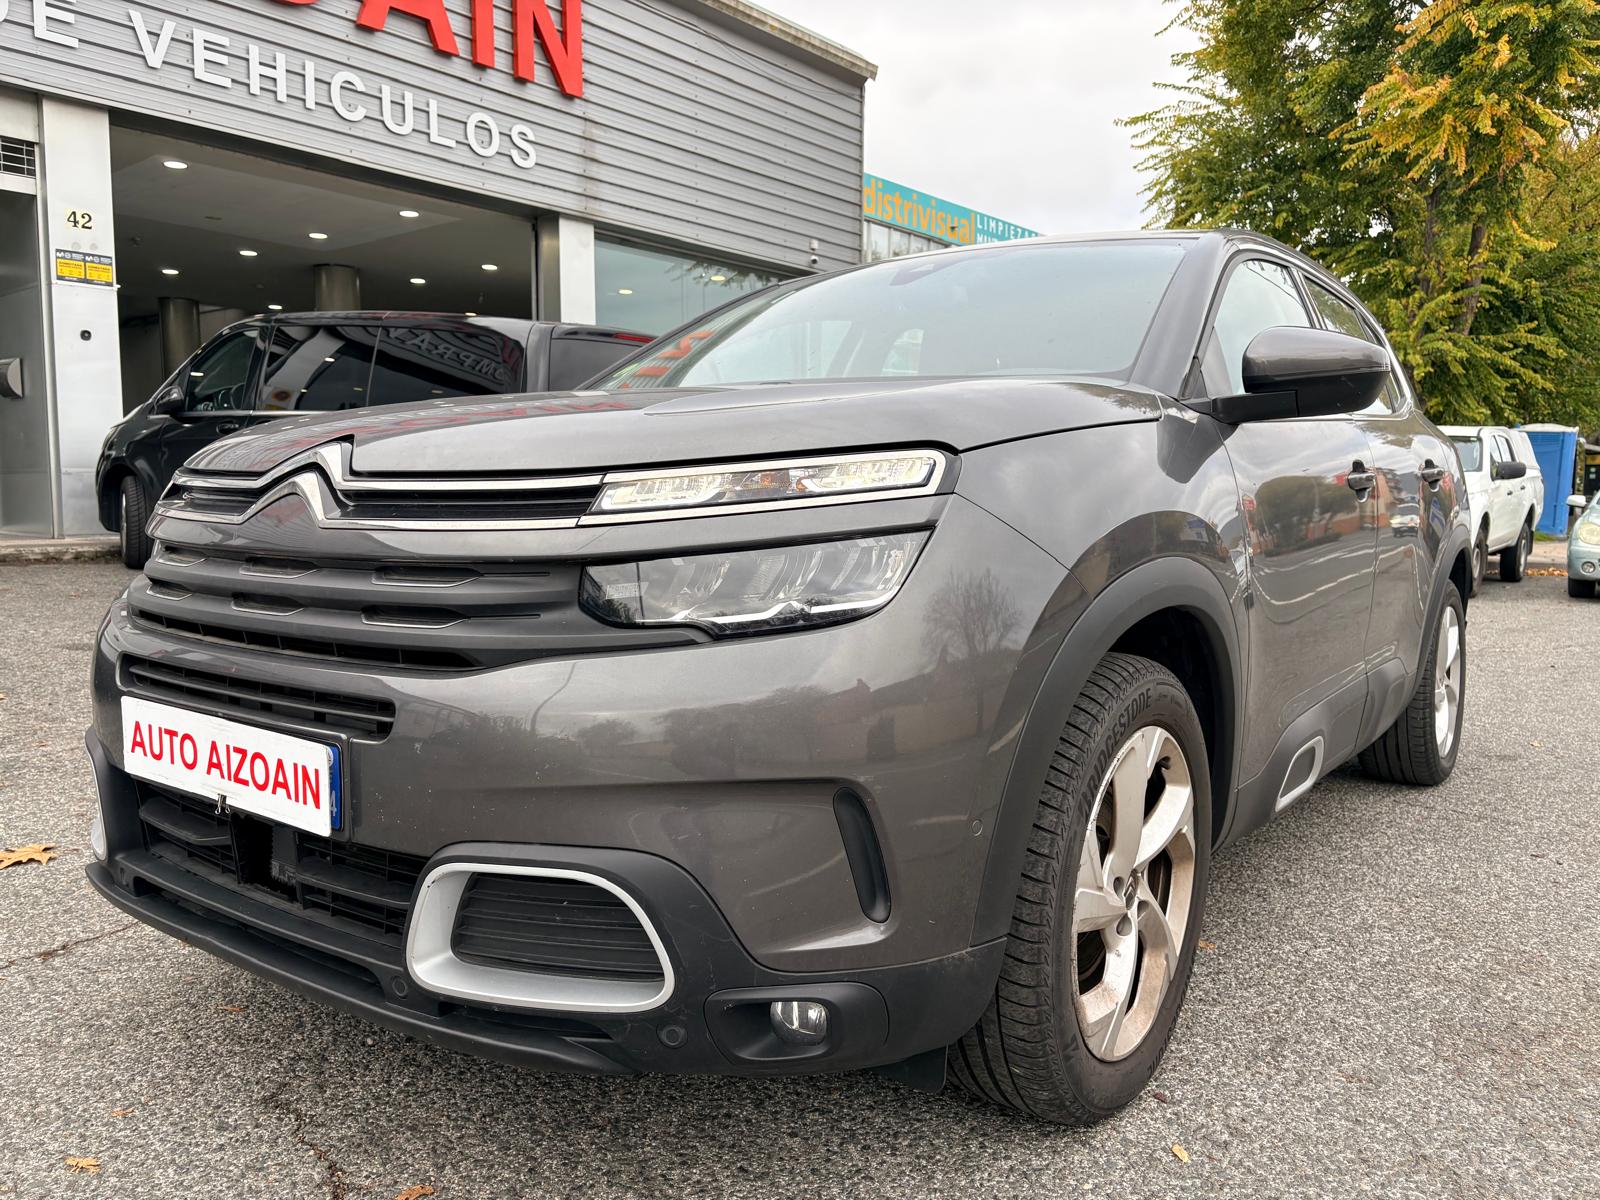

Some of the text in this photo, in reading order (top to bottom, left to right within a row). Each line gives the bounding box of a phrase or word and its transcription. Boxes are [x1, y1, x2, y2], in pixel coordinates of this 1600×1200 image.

[0, 0, 538, 170] E VEHICULOS
[270, 0, 584, 98] AIN
[66, 210, 93, 230] 42
[864, 178, 976, 246] distrivisual
[130, 720, 321, 810] AUTO AIZOAIN
